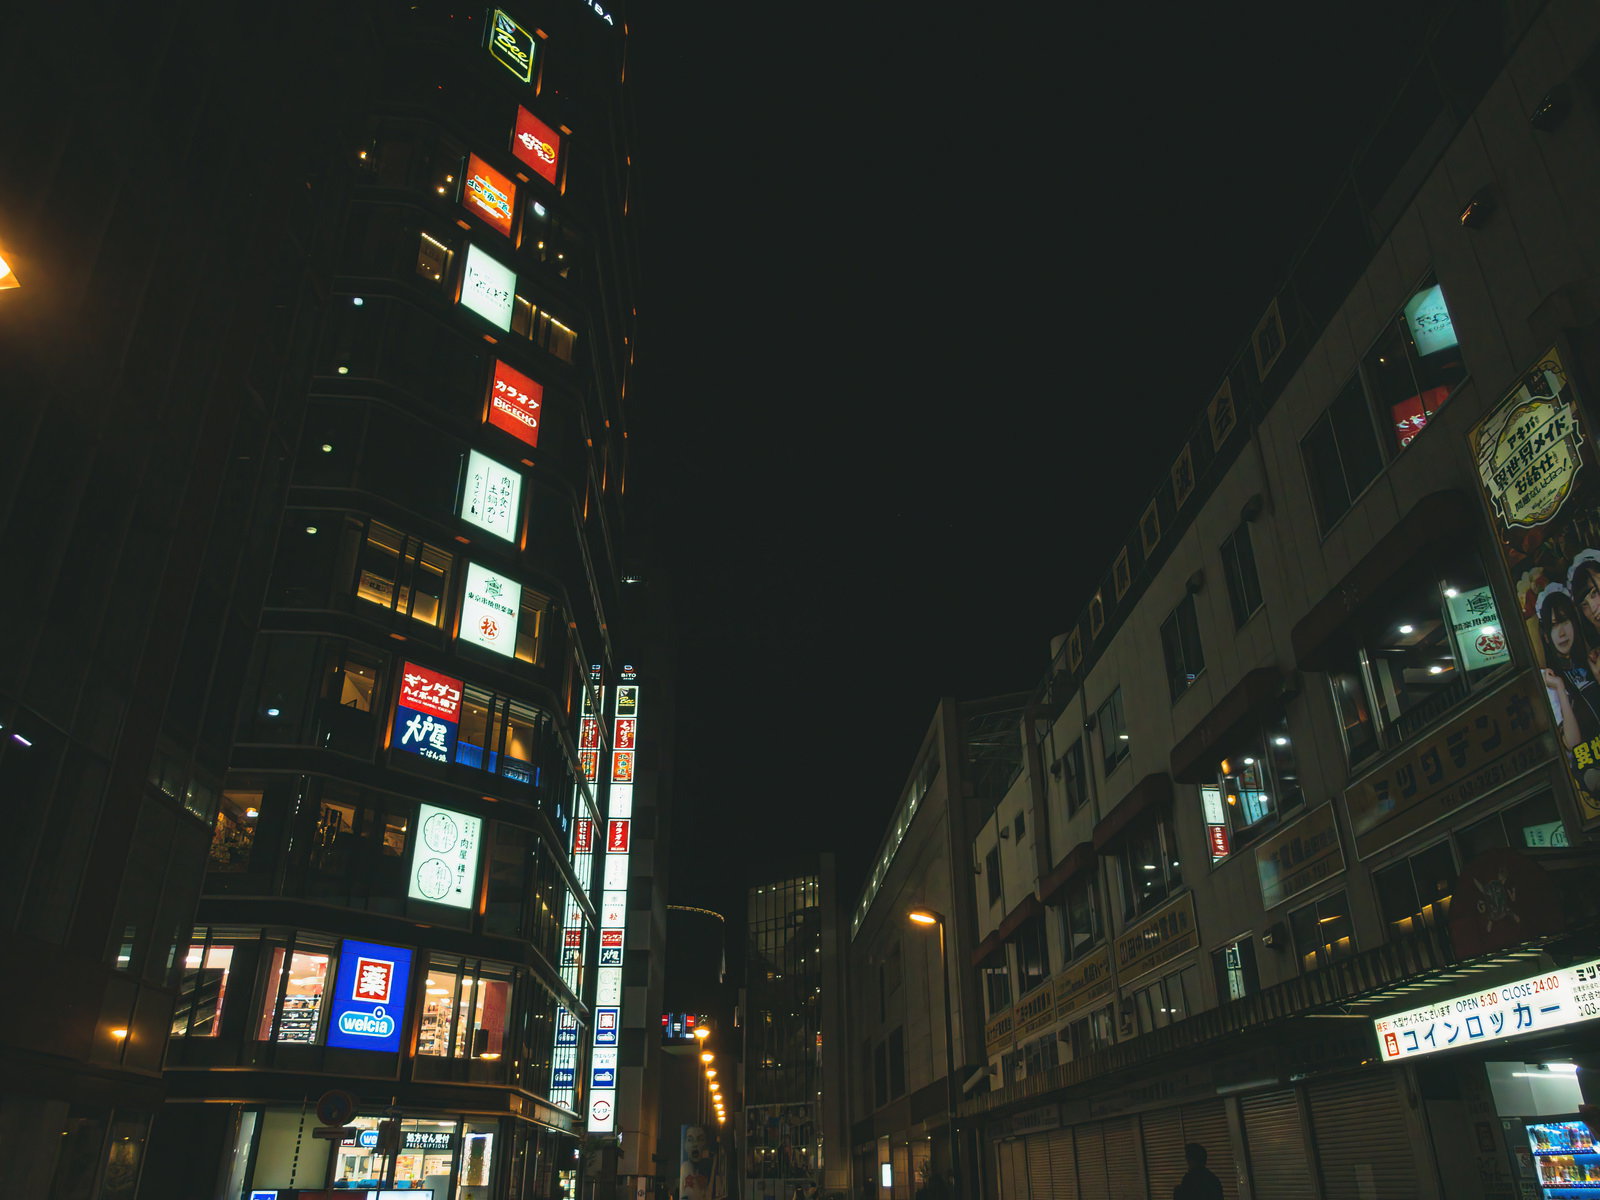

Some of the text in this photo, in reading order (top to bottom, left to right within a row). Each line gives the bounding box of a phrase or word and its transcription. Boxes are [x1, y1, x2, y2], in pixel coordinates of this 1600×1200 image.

[495, 380, 540, 410] カラオケ
[493, 397, 512, 414] BIG
[512, 406, 537, 428] ECHO
[480, 618, 498, 637] 松
[404, 673, 461, 701] ギンダコ
[401, 714, 448, 752] 大戸屋
[615, 821, 624, 847] カラオケ
[457, 839, 469, 885] 肉屋横丁
[358, 965, 388, 996] 薬
[1455, 997, 1479, 1013] OPEN
[1480, 992, 1498, 1007] 5:30
[1502, 983, 1532, 1001] CLOSE
[1532, 975, 1559, 994] 24:00
[343, 1014, 388, 1034] welcia
[1403, 1002, 1560, 1052] コインロッカー
[406, 1132, 450, 1144] 処方せん受付
